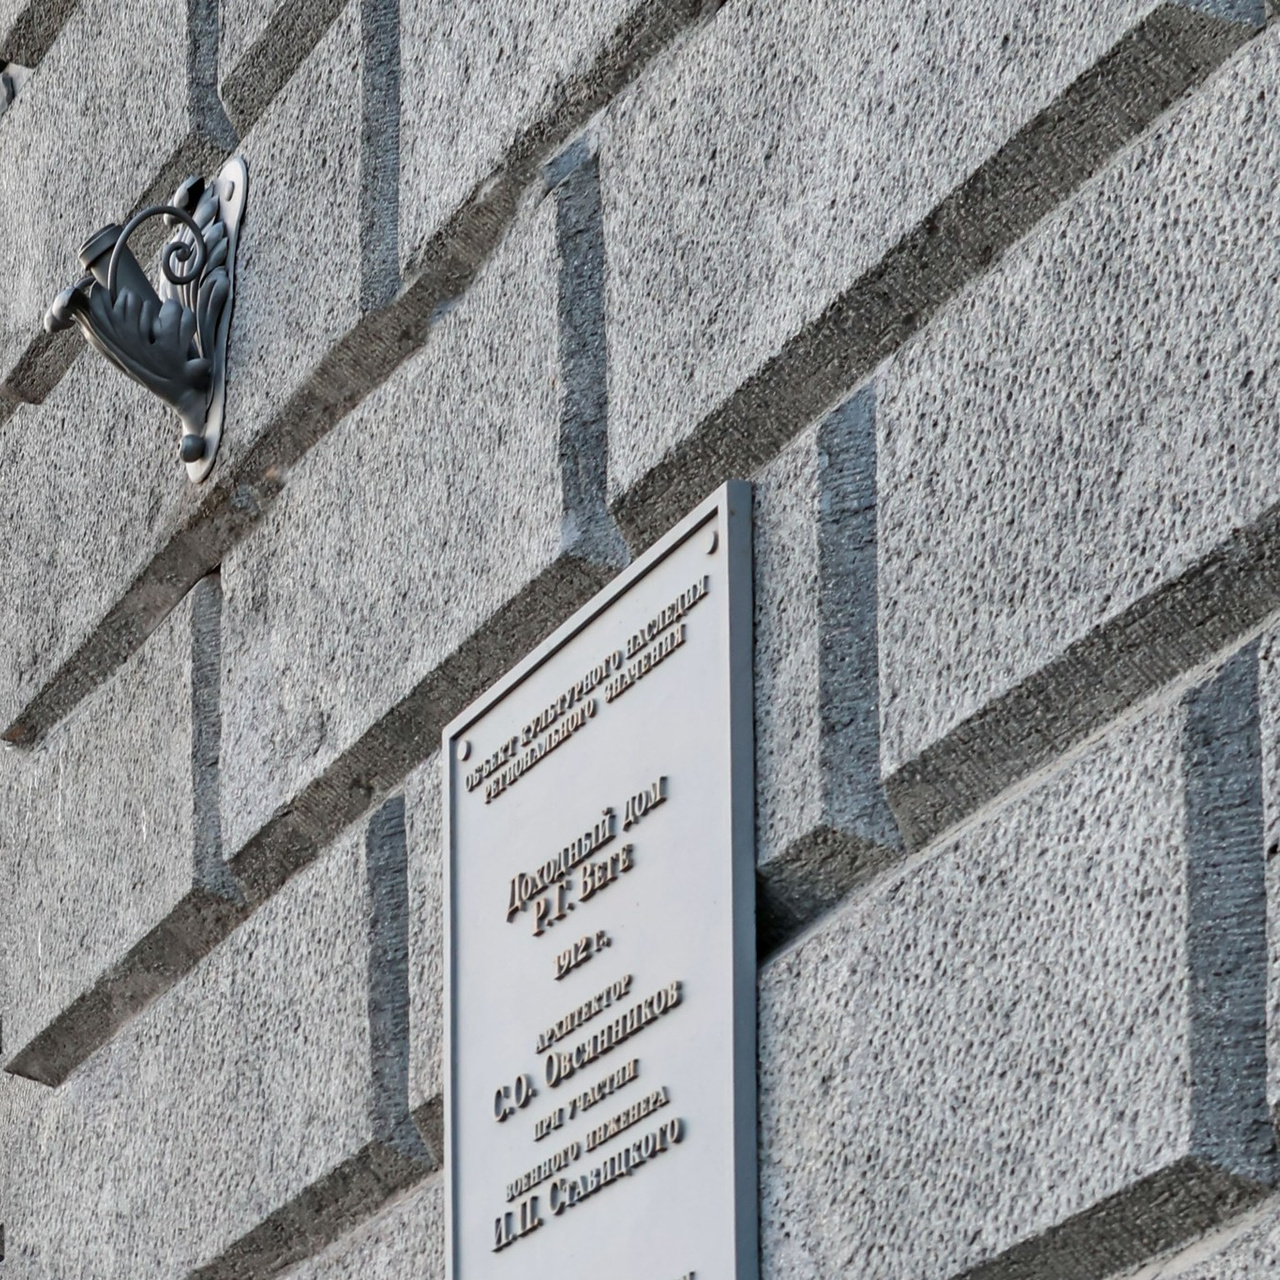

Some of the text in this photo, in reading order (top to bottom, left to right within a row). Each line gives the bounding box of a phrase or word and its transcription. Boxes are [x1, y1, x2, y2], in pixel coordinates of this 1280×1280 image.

[465, 575, 710, 792] ОБЪЕКТ КУЛЬТУРНОГО НАСЛЕДИЯ
[485, 623, 687, 804] РЕГИОНАЛЬНОГО ЗНАЧЕНИЯ
[554, 936, 593, 981] 1912
[536, 974, 633, 1054] АРХИТЕКТОР
[506, 1085, 670, 1203] ВОЕННОГО ИНЖЕНЕРА
[534, 1058, 640, 1142] ПРИ УЧАСТИИ
